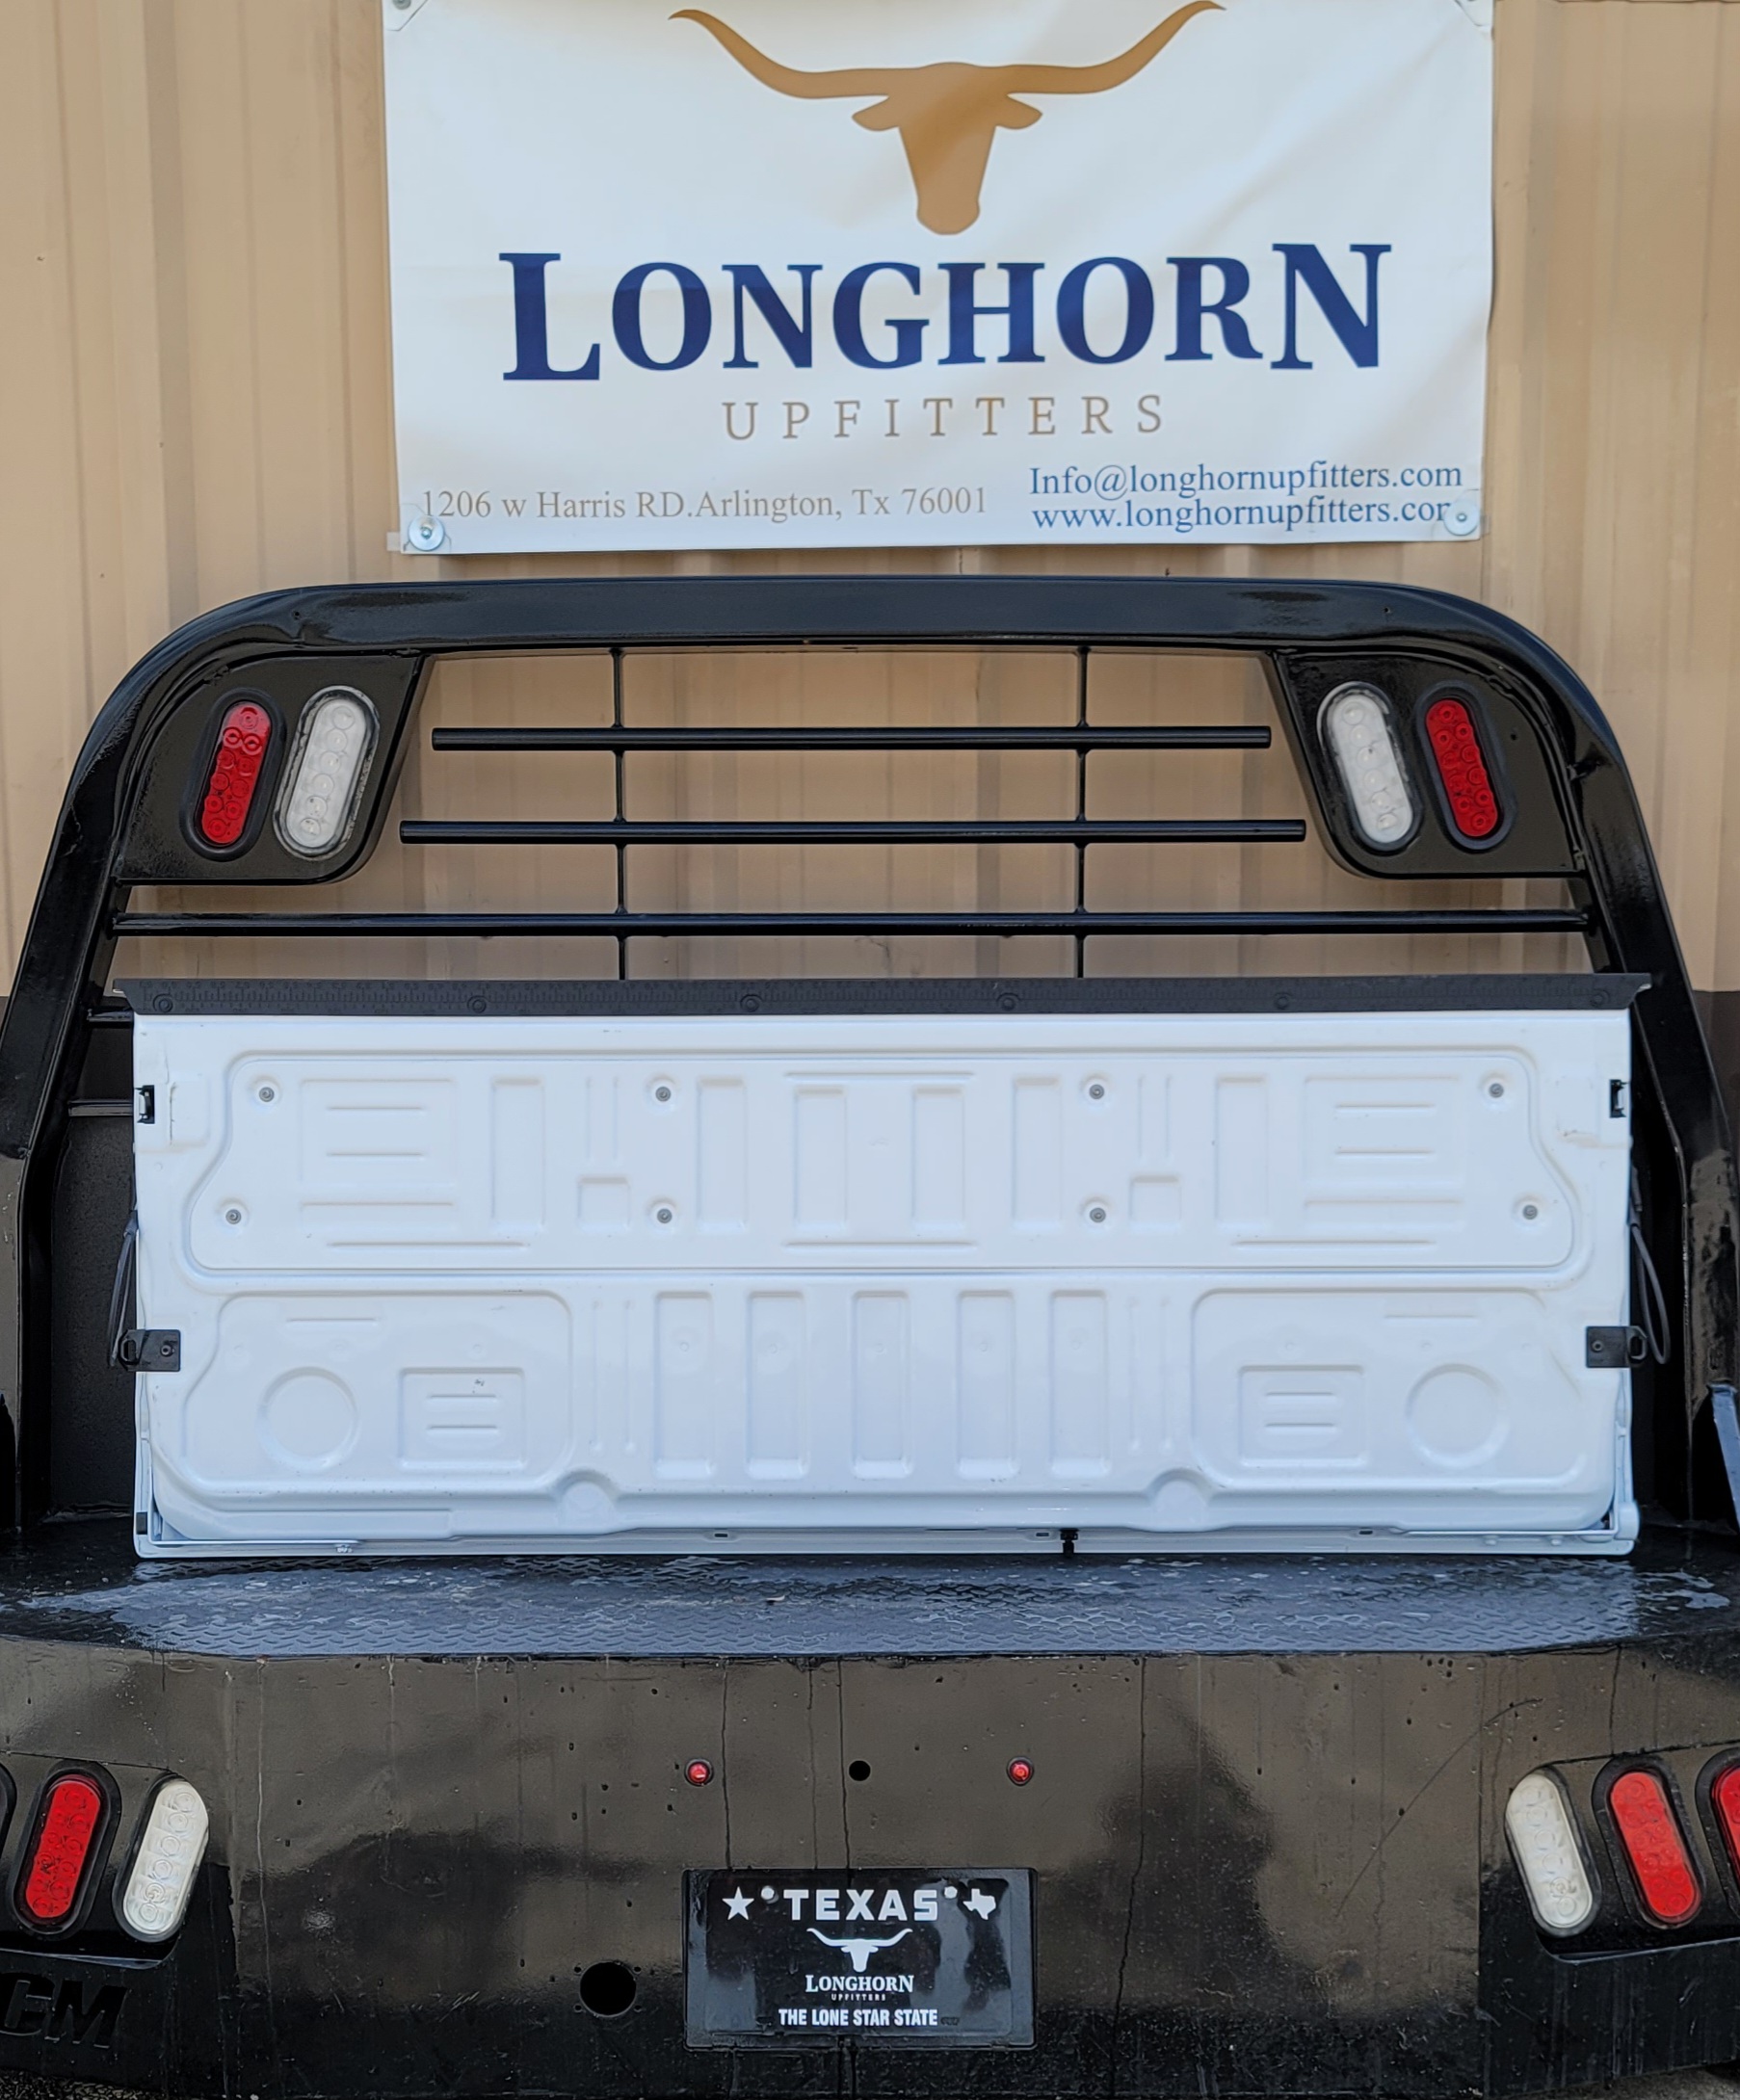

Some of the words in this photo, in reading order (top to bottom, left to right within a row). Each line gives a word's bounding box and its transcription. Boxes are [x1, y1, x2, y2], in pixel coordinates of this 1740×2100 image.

[498, 243, 1392, 381] LONGHORN
[721, 394, 1162, 441] UPFITTERS
[1029, 459, 1463, 501] Info@longhornupfitters.com
[424, 490, 491, 517] 1206
[501, 499, 527, 518] w
[537, 490, 626, 518] Harris
[852, 488, 890, 516] Tx
[901, 486, 986, 516] 76001
[783, 1889, 938, 1921] TEXAS
[805, 1975, 914, 1993] LONGHORN
[830, 1993, 886, 2002] UPFITTERS
[778, 2008, 806, 2025] THE
[812, 2008, 849, 2026] LONE
[853, 2008, 889, 2026] STAR
[894, 2008, 937, 2026] STATE
